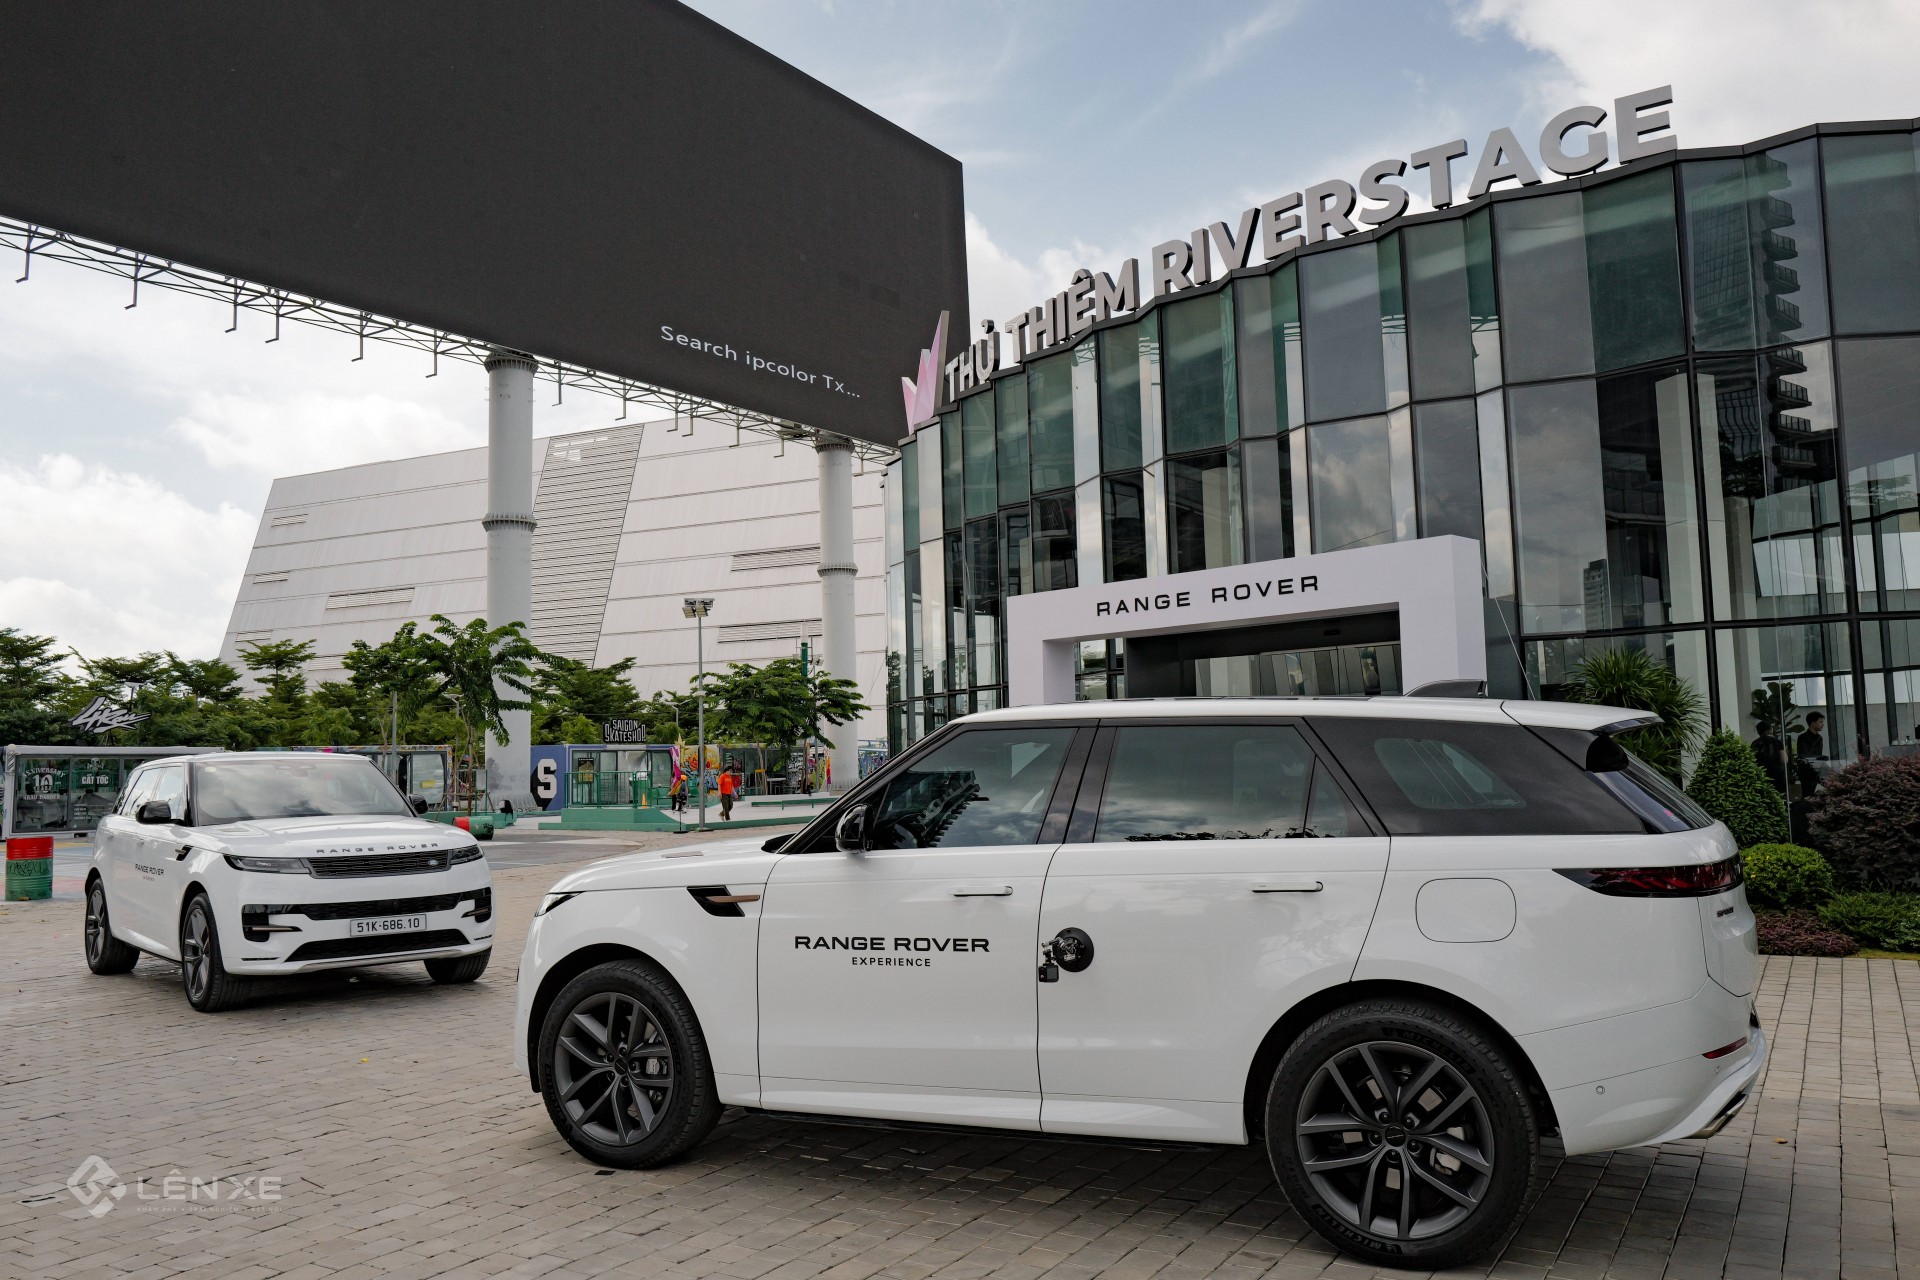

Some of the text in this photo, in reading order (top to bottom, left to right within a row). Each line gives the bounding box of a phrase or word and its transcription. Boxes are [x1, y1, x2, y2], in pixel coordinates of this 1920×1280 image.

[945, 84, 1678, 402] THỦ THIÊM RIVERSTAGE
[660, 325, 737, 361] Search
[745, 350, 817, 384] ipcolor
[1096, 575, 1319, 617] RANGE ROVER
[604, 723, 646, 742] SKATESHOP
[612, 719, 638, 731] SAIGON
[33, 774, 53, 793] 10
[537, 758, 558, 799] S
[386, 842, 438, 851] ROVER
[134, 863, 165, 876] RANGE ROVER
[357, 917, 420, 933] 51K-686.10
[794, 935, 990, 953] RANGE ROVER
[851, 956, 931, 967] EXPERIENCE
[1312, 1205, 1382, 1250] MICHELIN
